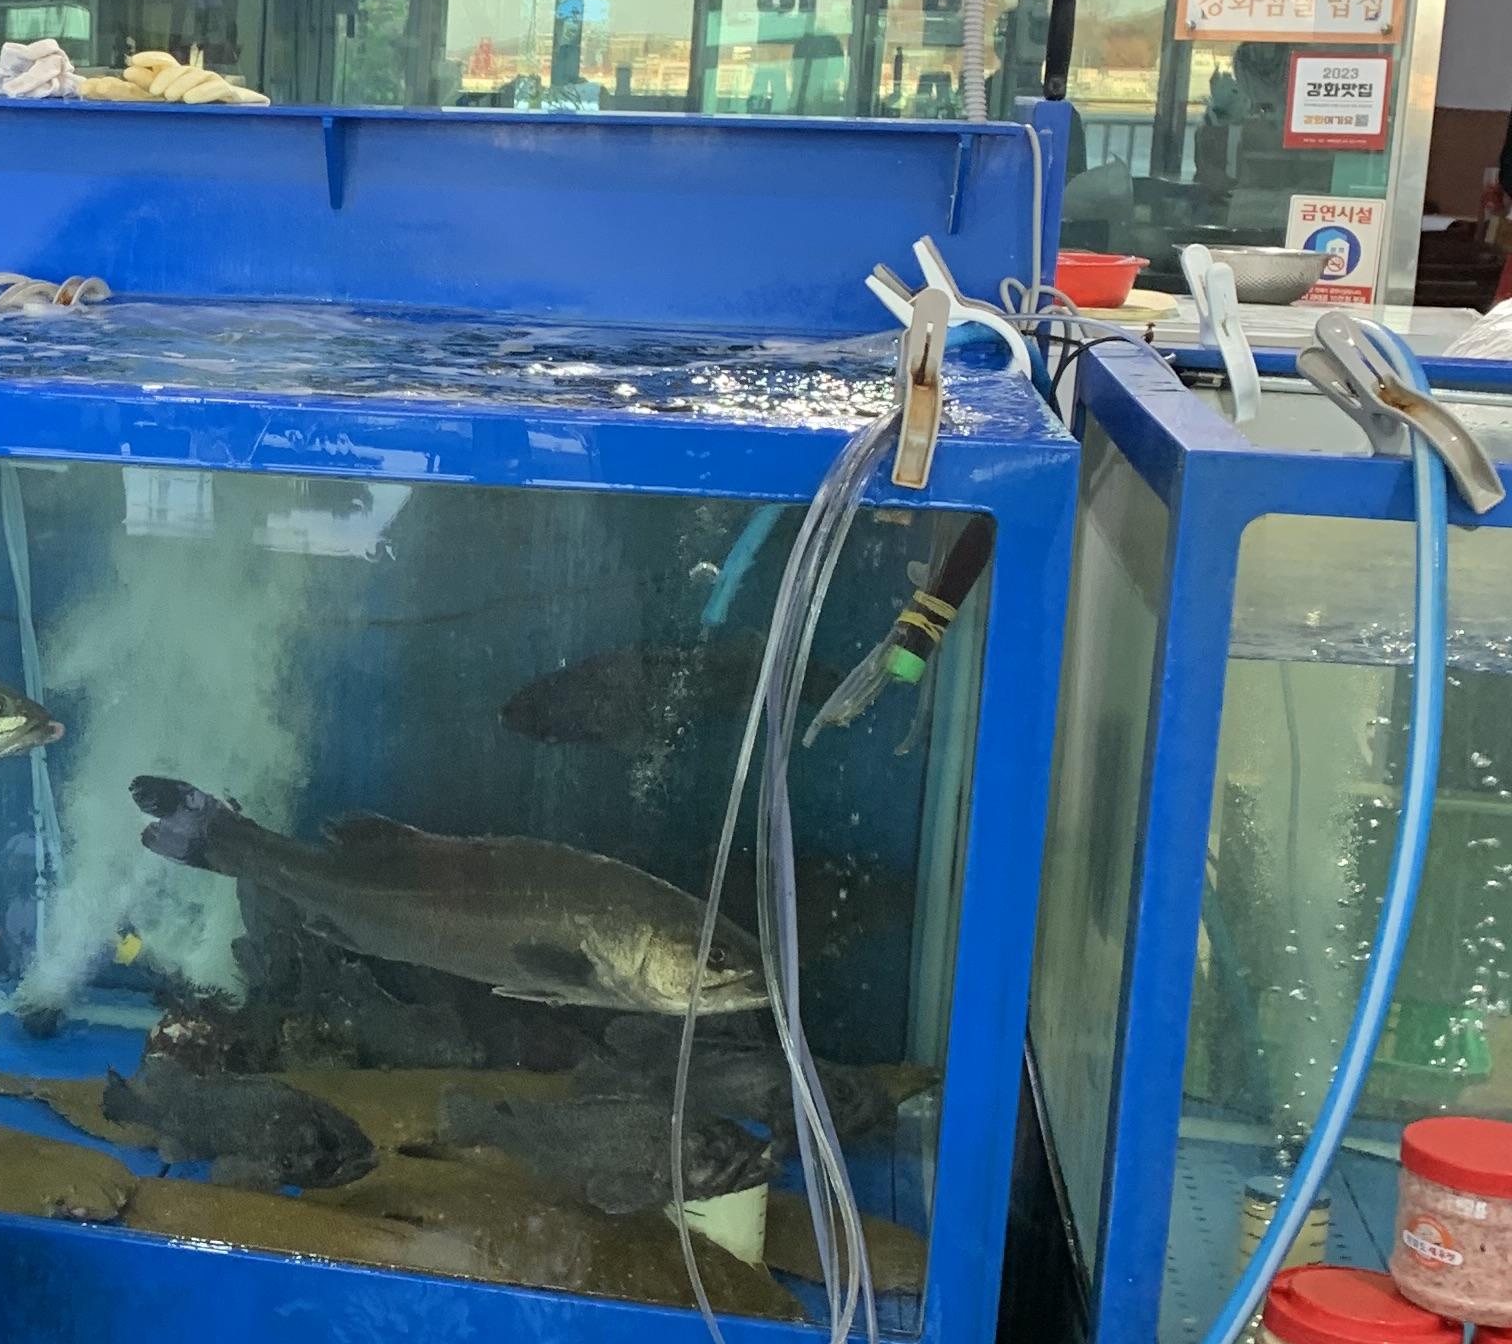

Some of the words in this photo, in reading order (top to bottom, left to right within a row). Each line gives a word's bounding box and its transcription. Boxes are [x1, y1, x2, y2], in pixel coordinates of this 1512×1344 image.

[1322, 67, 1359, 80] 2023
[1306, 82, 1373, 98] 강화맛집
[1301, 203, 1373, 225] 금연시설
